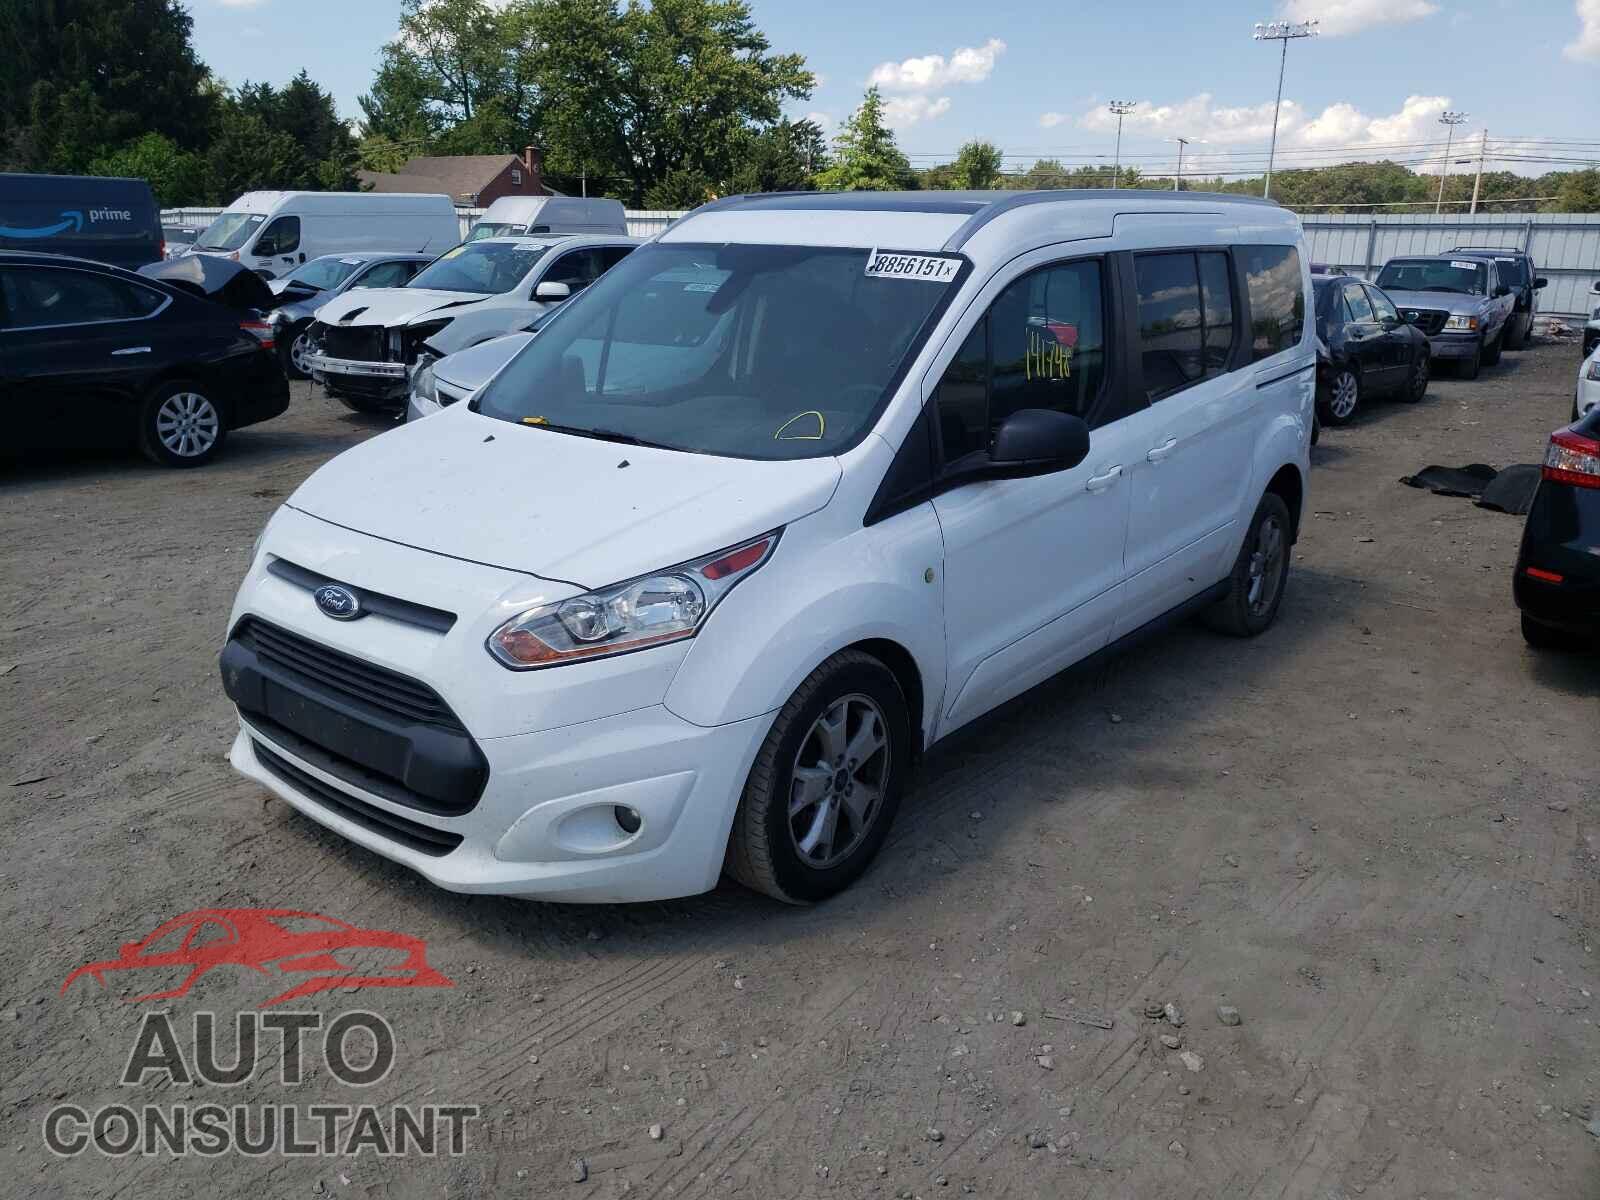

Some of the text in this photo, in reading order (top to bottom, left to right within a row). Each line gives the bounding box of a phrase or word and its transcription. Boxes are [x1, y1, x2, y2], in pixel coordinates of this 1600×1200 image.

[89, 207, 132, 223] prime
[874, 256, 946, 276] 8856151
[321, 589, 346, 610] Ford
